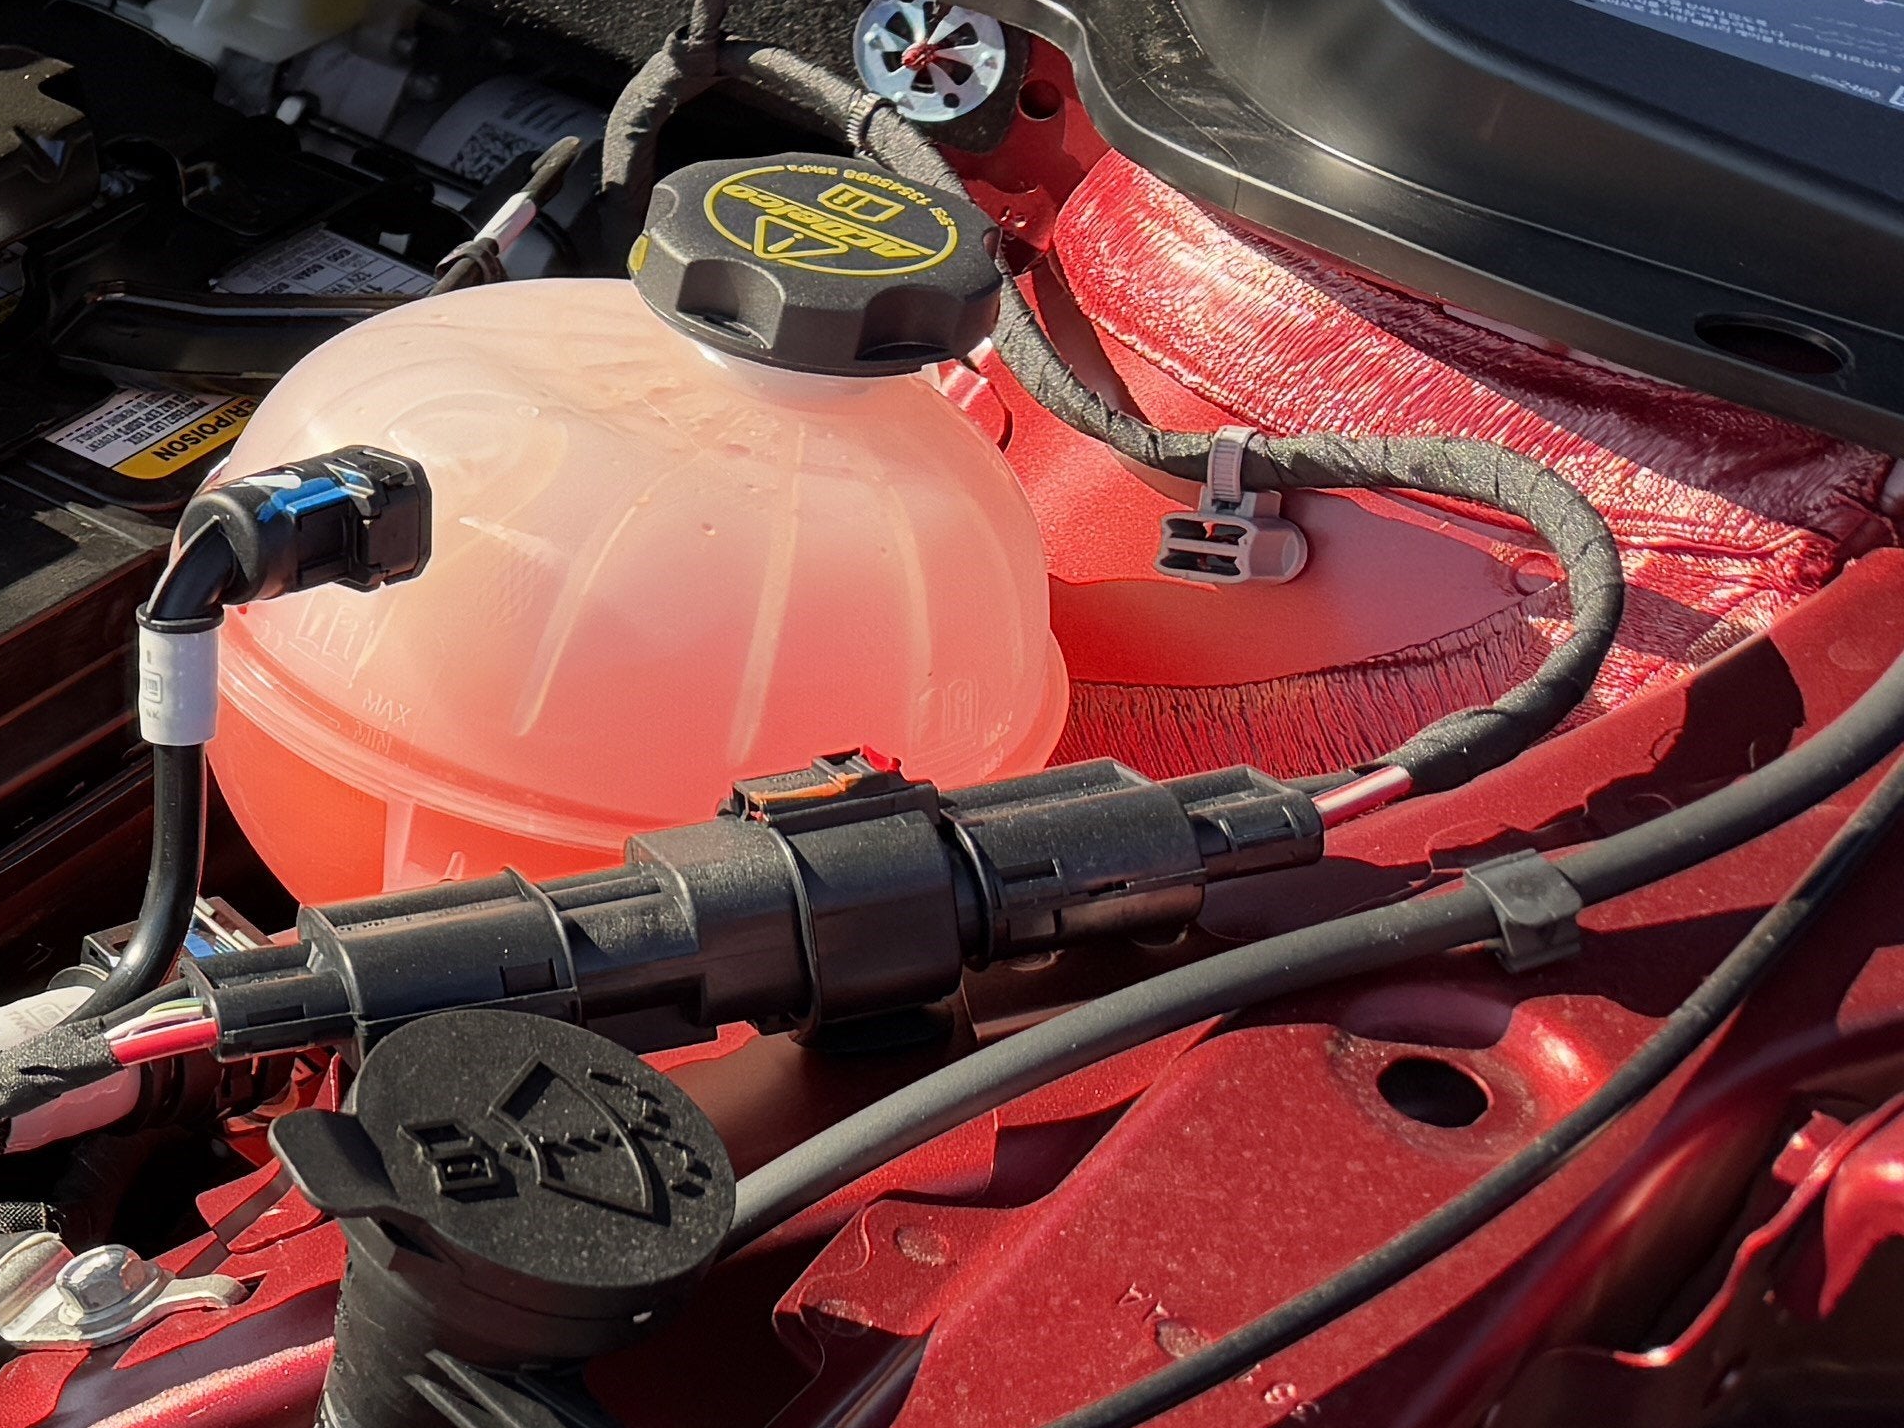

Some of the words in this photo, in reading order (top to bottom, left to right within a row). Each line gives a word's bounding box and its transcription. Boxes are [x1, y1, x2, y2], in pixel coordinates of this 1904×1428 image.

[722, 183, 923, 259] ACDelco
[362, 689, 412, 727] MAX
[353, 720, 393, 755] MIN
